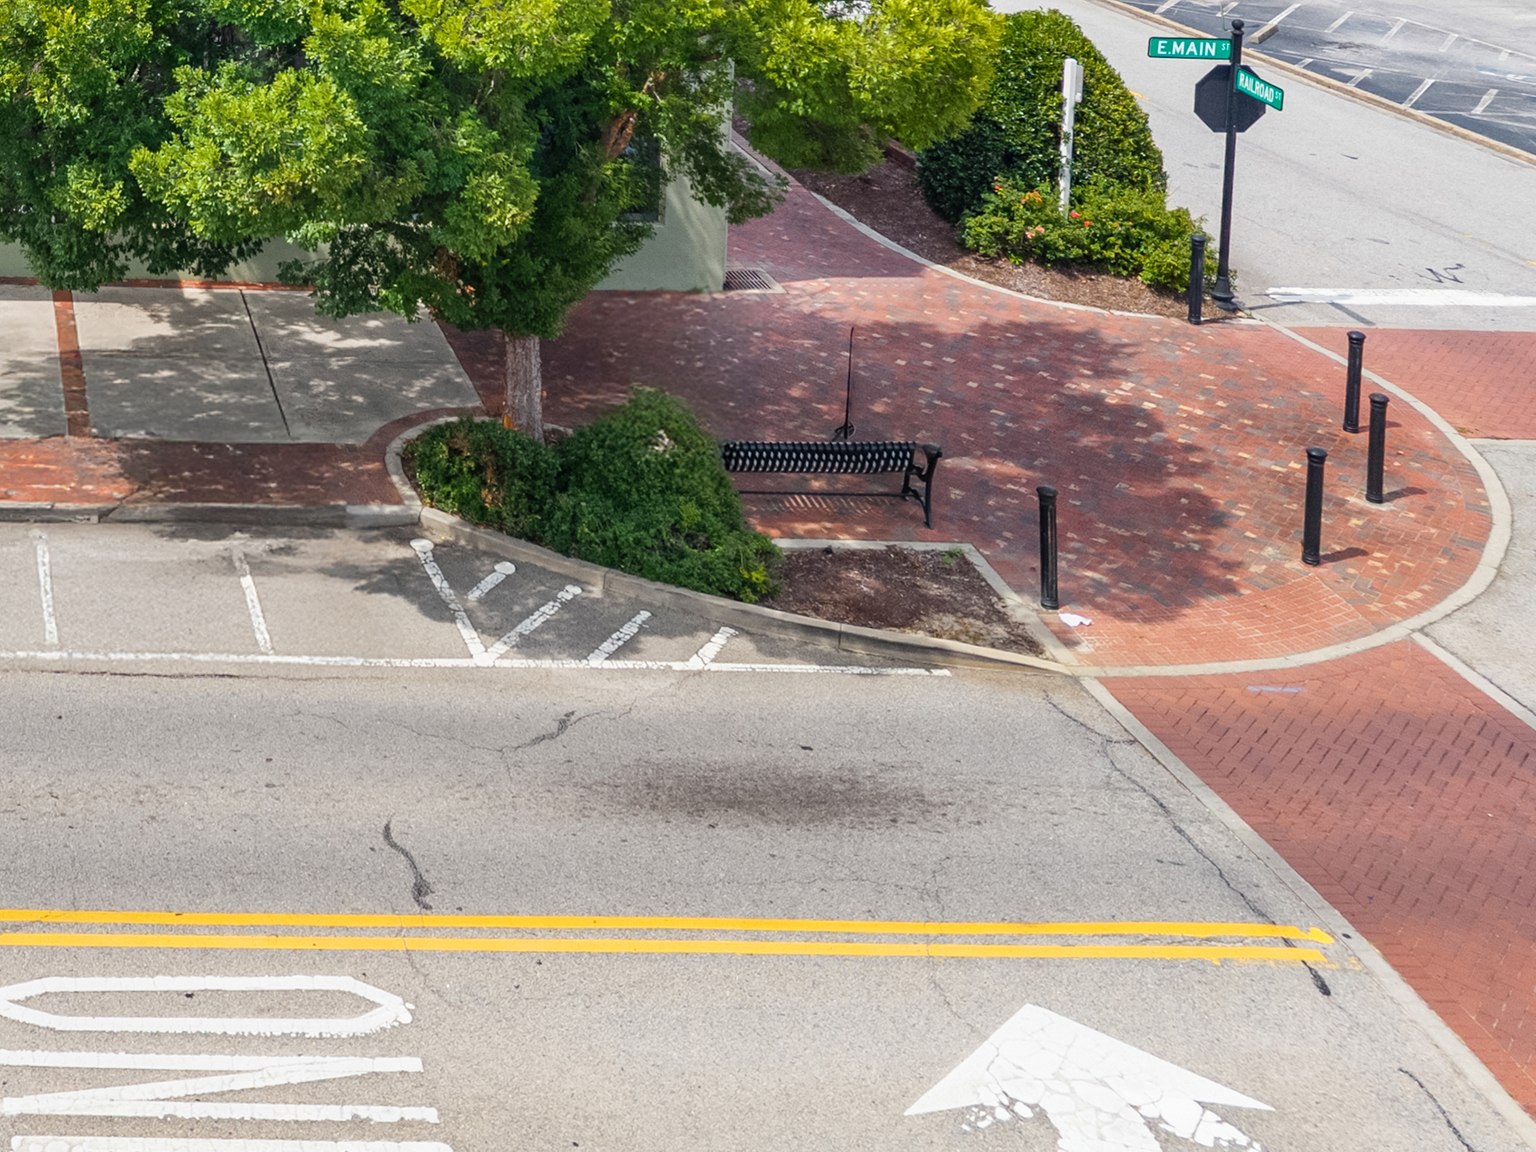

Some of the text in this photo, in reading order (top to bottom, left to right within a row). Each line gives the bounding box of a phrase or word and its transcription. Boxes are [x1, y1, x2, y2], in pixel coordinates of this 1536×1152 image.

[1221, 43, 1231, 51] ST
[1239, 73, 1282, 103] RAILROAD ST
